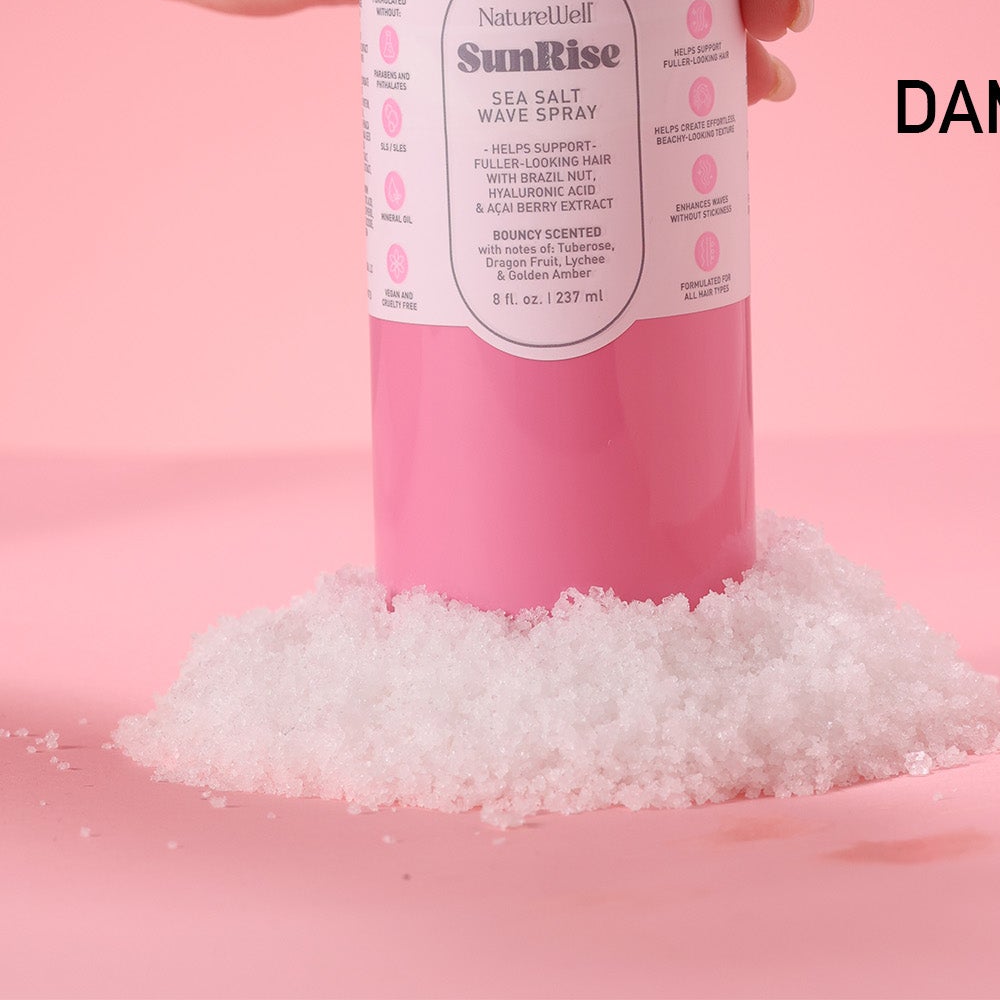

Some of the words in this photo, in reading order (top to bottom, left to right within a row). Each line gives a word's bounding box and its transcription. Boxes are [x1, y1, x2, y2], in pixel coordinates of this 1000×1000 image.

[376, 7, 402, 18] WITHOUT:
[478, 2, 593, 27] NatureWell
[457, 38, 621, 74] SunRise
[674, 46, 696, 57] HELPS
[696, 42, 722, 54] SUPPORT
[663, 53, 718, 69] FULLER-LOOKING
[719, 50, 730, 61] HAIR
[373, 69, 398, 80] PARABENS
[398, 72, 410, 81] AND
[376, 80, 407, 91] PHTHALATES
[492, 90, 528, 106] SEA
[534, 88, 581, 104] SALT
[478, 108, 529, 123] WAVE
[536, 105, 598, 122] SPRAY
[654, 123, 679, 135] HELPS
[680, 120, 705, 132] CREATE
[656, 128, 715, 146] BEACHY-LOOKING
[715, 124, 735, 137] TEXTURE
[380, 142, 389, 151] SLS
[393, 143, 407, 153] SLES
[492, 143, 531, 155] HELPS
[474, 156, 579, 169] FULLER-LOOKING
[582, 154, 612, 166] HAIR
[486, 172, 517, 184] WITH
[520, 171, 564, 183] BRAZIL
[567, 170, 597, 183] NUT,
[488, 186, 564, 199] HYALURONIC
[568, 184, 596, 197] ACID
[475, 203, 484, 214] &
[487, 202, 514, 216] AÇAI
[517, 200, 558, 213] BERRY
[561, 198, 614, 212] EXTRACT
[675, 199, 711, 213] ENHANCES
[712, 195, 729, 207] WAVES
[381, 213, 402, 224] MINERAL
[403, 215, 413, 225] OIL
[670, 211, 702, 223] WITHOUT
[703, 204, 732, 219] STICKINESS
[493, 229, 542, 241] BOUNCY
[545, 226, 602, 240] SCENTED
[478, 244, 502, 255] with
[505, 243, 537, 254] notes
[540, 242, 555, 254] of:
[557, 241, 615, 254] Tuberose,
[486, 257, 527, 270] Dragon
[530, 255, 562, 268] Fruit,
[565, 254, 606, 267] Lychee
[496, 270, 506, 281] &
[508, 269, 550, 281] Golden
[552, 268, 592, 280] Amber
[680, 276, 721, 291] FORMULATED
[722, 273, 732, 284] FOR
[384, 288, 401, 299] VEGAN
[401, 291, 414, 300] AND
[492, 293, 501, 306] 8
[505, 293, 518, 306] fl.
[523, 295, 543, 306] oz.
[556, 290, 580, 304] 237
[585, 289, 604, 303] ml
[684, 290, 697, 302] ALL
[698, 287, 713, 299] HAIR
[714, 284, 730, 296] TYPES
[382, 298, 402, 310] CRUELTY
[402, 301, 418, 311] FREE
